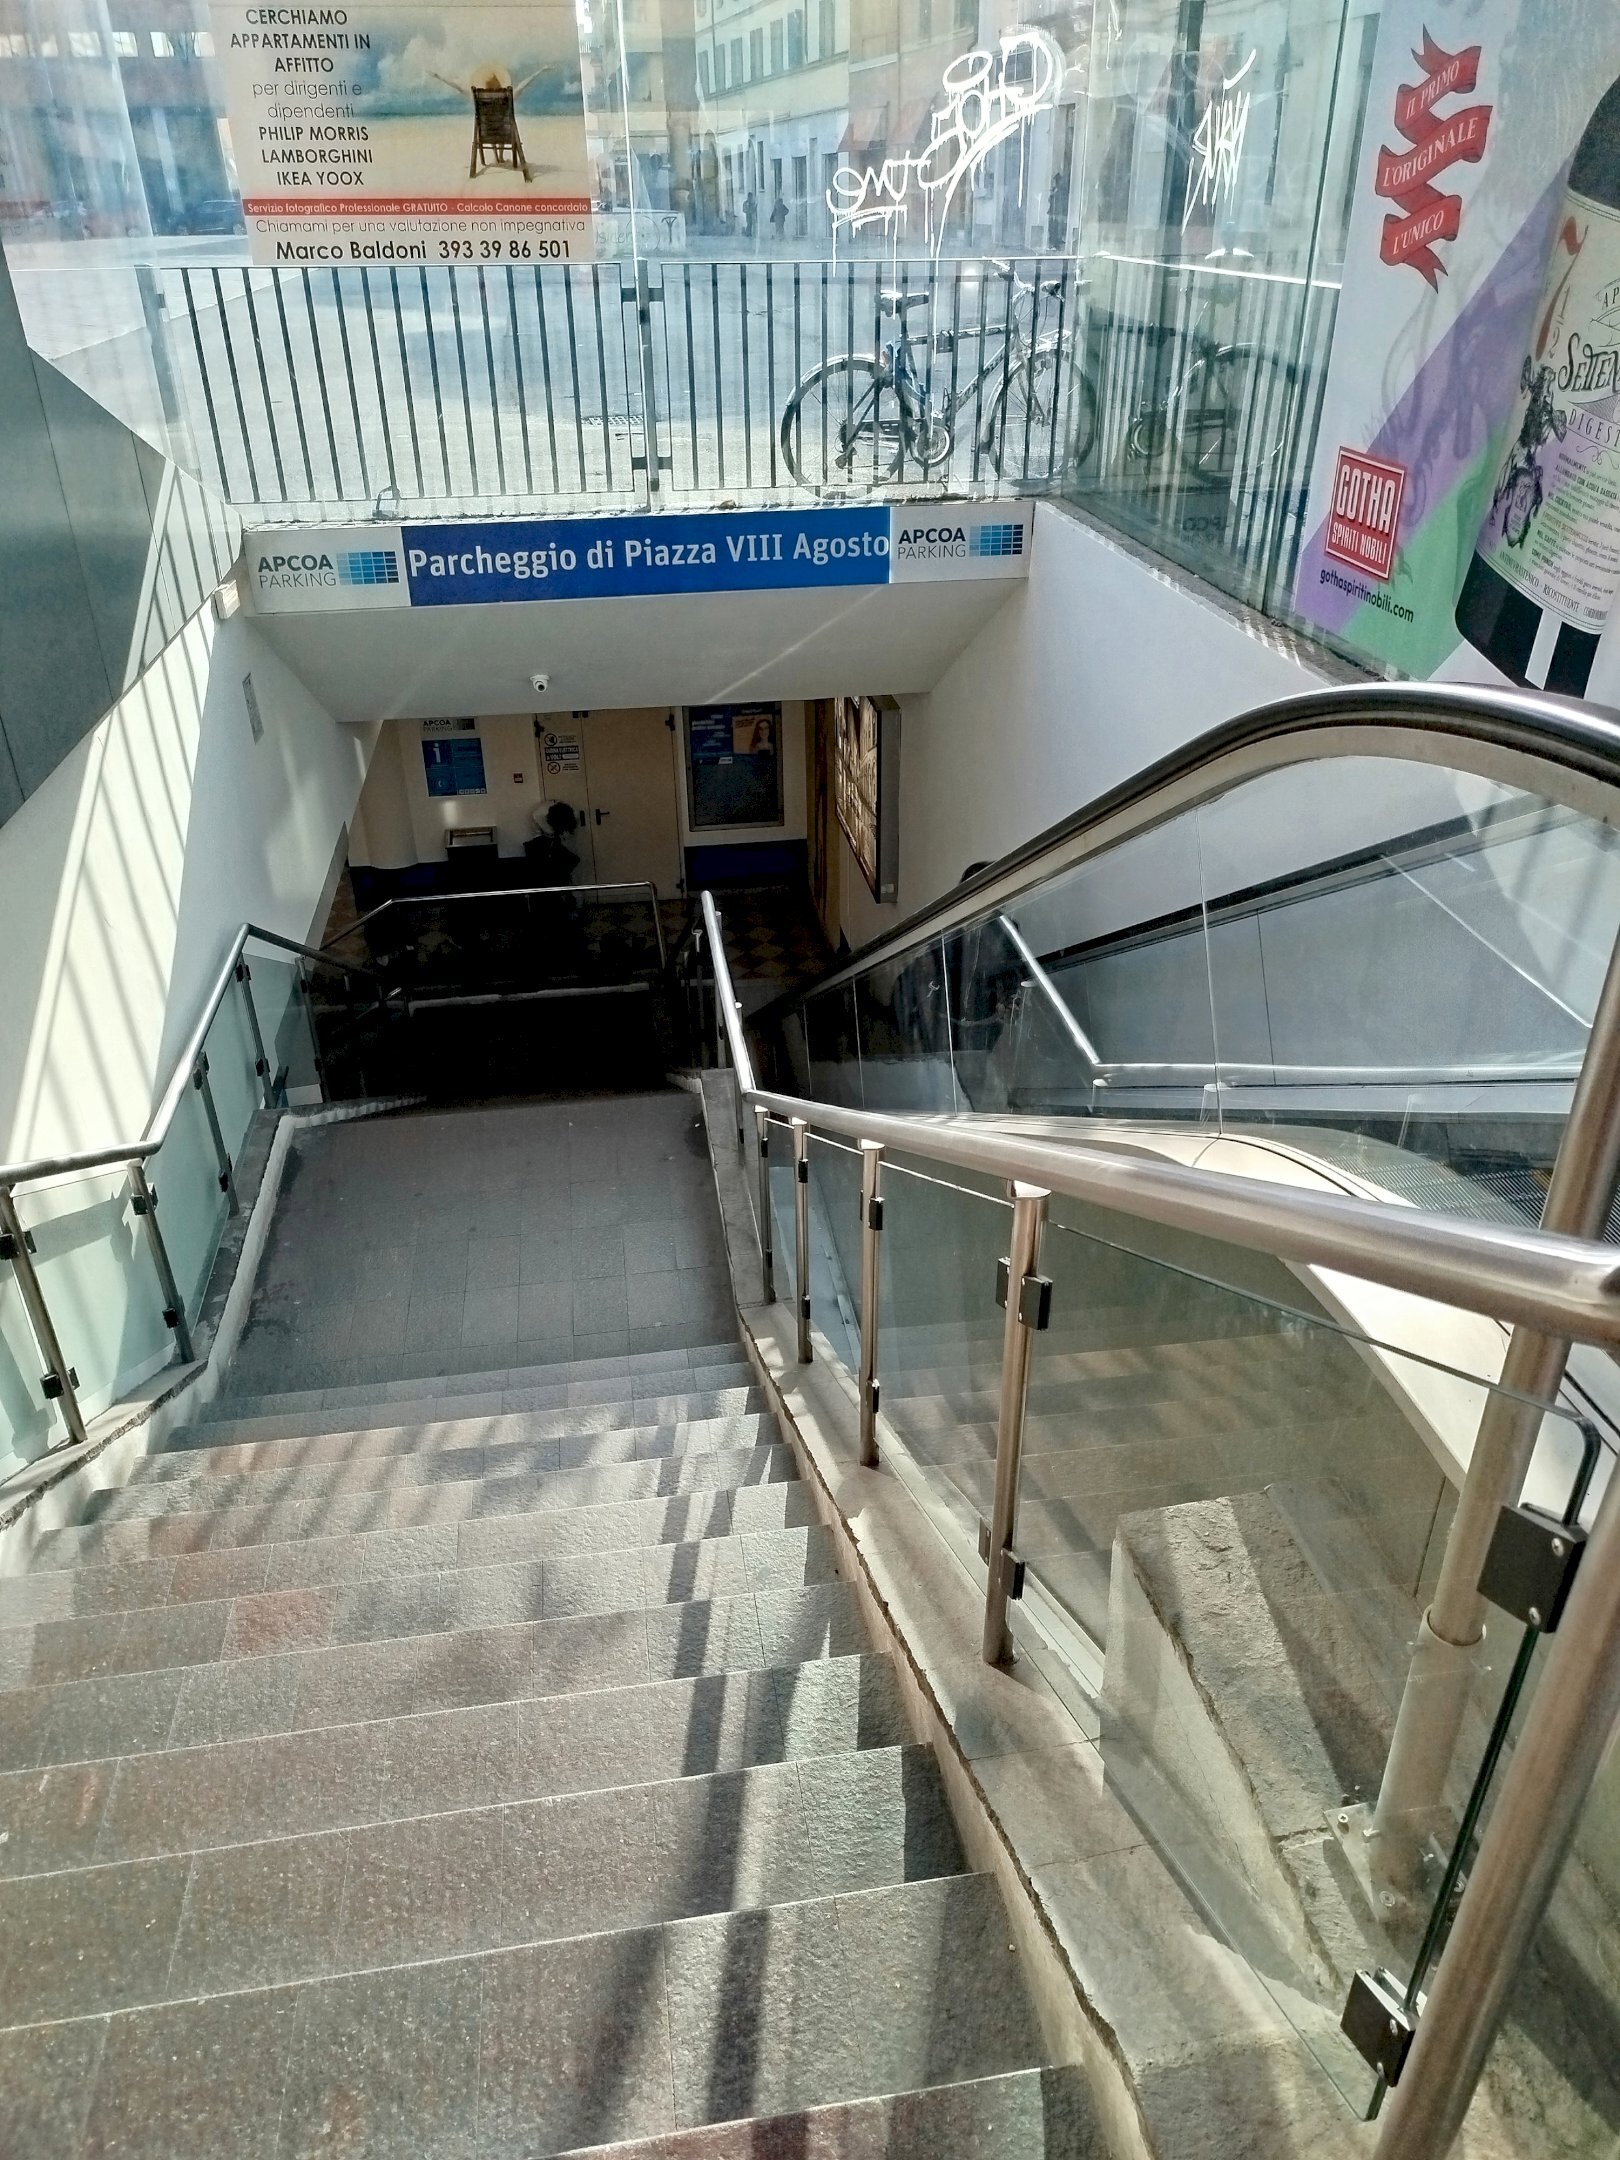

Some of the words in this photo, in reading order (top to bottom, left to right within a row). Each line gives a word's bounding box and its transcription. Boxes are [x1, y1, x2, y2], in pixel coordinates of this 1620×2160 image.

[245, 9, 348, 26] CERCHIAMO
[230, 33, 350, 49] APPARTAMENTI
[354, 33, 371, 49] IN
[274, 57, 334, 73] AFFITTO
[252, 83, 279, 98] per
[284, 80, 348, 99] dirigenti
[352, 83, 362, 96] e
[1406, 100, 1416, 120] IL
[1420, 60, 1460, 110] PRIMO
[267, 102, 354, 121] dipendenti
[258, 126, 303, 141] PHILIP
[309, 126, 369, 141] MORRIS
[261, 149, 373, 164] LAMBORGHINI
[1382, 116, 1479, 187] L'ORIGINALE
[276, 171, 313, 186] IKEA
[316, 171, 364, 186] YOOX
[248, 203, 284, 214] Servizio
[285, 203, 338, 215] fotografico
[339, 202, 401, 214] Professionale
[402, 202, 448, 213] GRATUITO
[456, 202, 494, 213] Calcolo
[495, 202, 533, 213] Canone
[534, 202, 589, 213] concordato
[255, 219, 328, 233] Chiamami
[331, 221, 355, 235] per
[358, 221, 386, 233] una
[389, 218, 467, 233] valutazione
[471, 220, 497, 232] non
[500, 218, 585, 234] impegnativa
[1392, 210, 1444, 255] L'UNICO
[276, 241, 343, 260] Marco
[350, 240, 427, 260] Baldoni
[438, 240, 474, 259] 393
[479, 240, 502, 259] 39
[509, 240, 532, 259] 86
[538, 240, 570, 259] 501
[1335, 464, 1396, 535] GOTHA
[897, 526, 967, 545] APCOA
[1331, 521, 1359, 553] SPIRITI
[1359, 533, 1387, 565] NOBILI
[408, 541, 577, 580] Parcheggio
[586, 540, 614, 569] di
[625, 536, 716, 568] Piazza
[726, 533, 784, 562] VIII
[793, 531, 889, 566] Agosto
[897, 543, 967, 560] PARKING
[257, 553, 335, 573] APCOA
[258, 571, 337, 589] PARKING
[1319, 567, 1414, 623] gothaspiritinobili.com
[423, 719, 451, 727] APCOA
